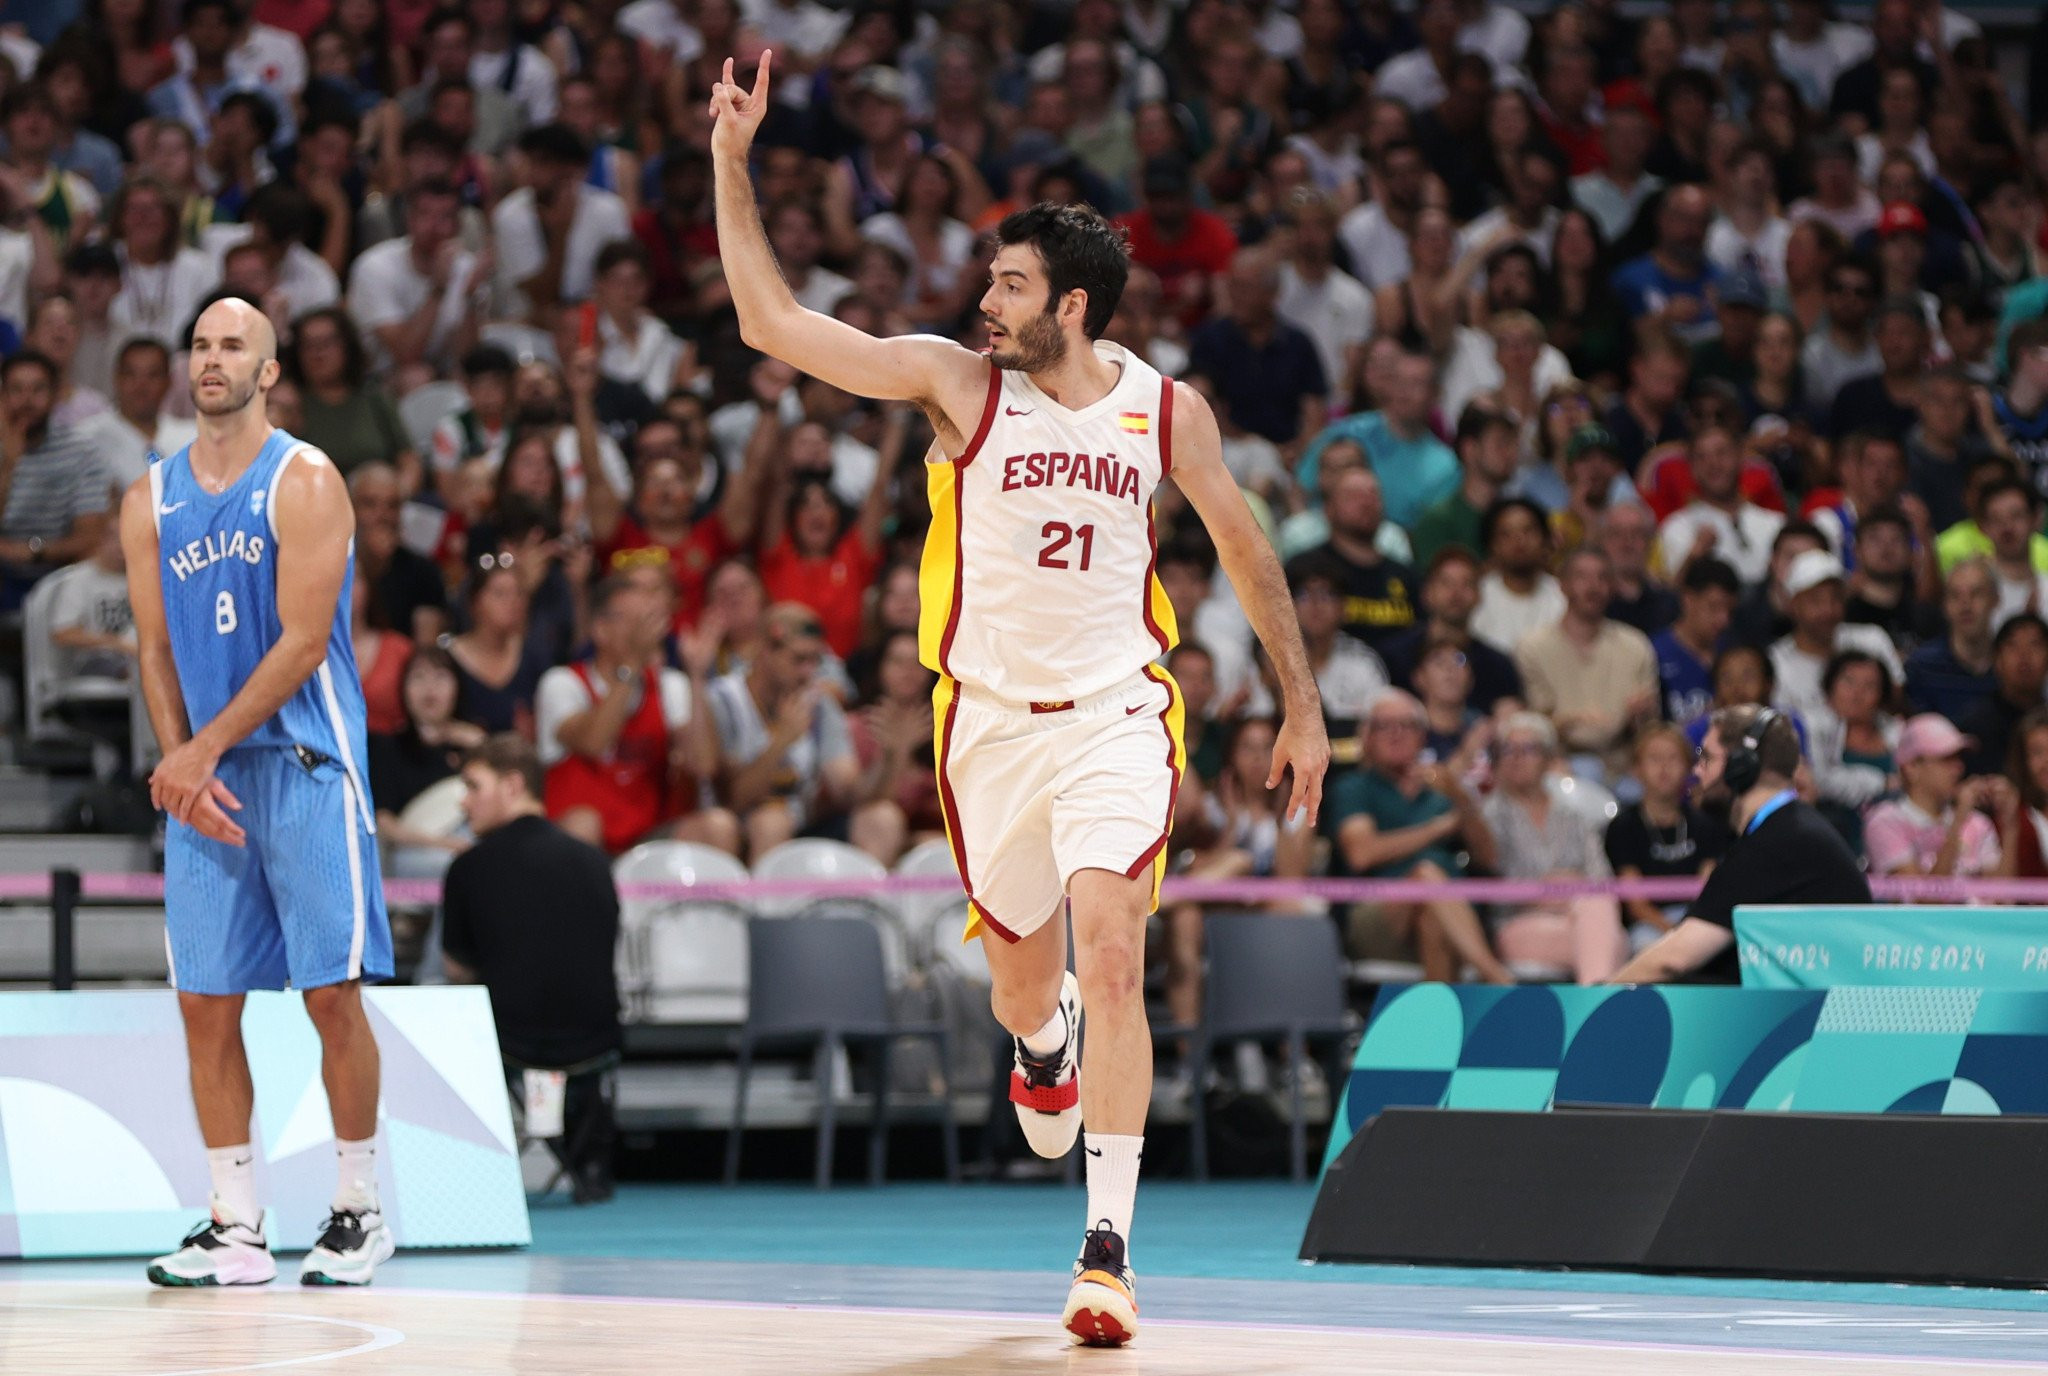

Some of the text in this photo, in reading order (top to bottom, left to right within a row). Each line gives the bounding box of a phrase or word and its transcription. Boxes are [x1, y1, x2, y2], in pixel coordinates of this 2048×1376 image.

[1002, 452, 1139, 505] ESPAÑA
[1037, 520, 1094, 571] 21
[215, 589, 238, 635] 8
[1863, 943, 1985, 972] PARIS 2024
